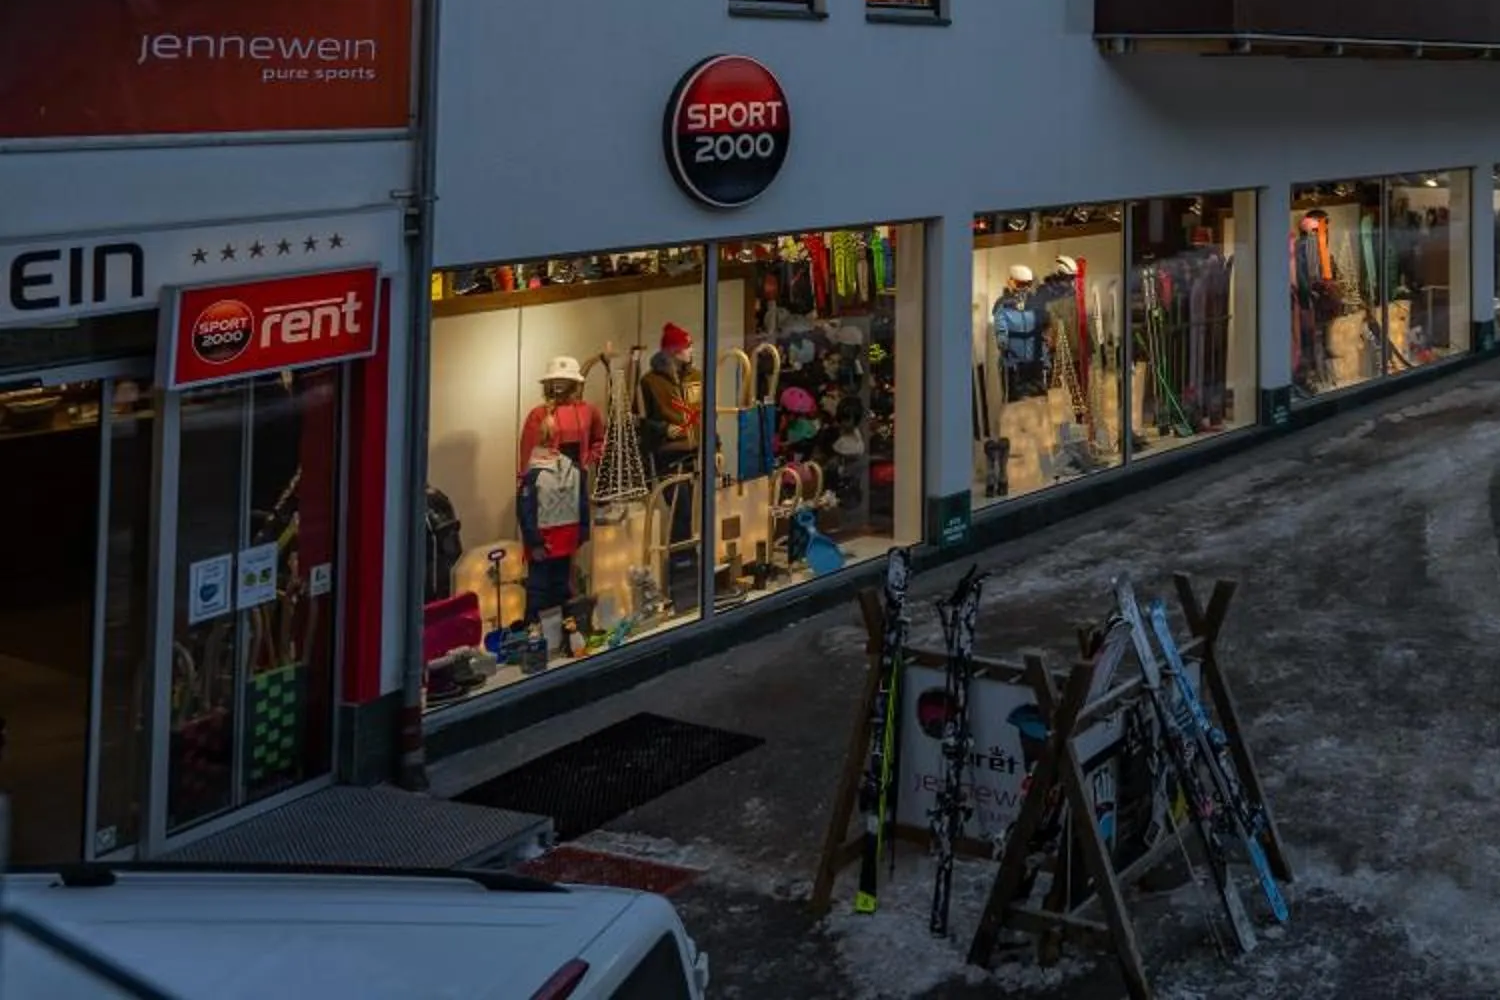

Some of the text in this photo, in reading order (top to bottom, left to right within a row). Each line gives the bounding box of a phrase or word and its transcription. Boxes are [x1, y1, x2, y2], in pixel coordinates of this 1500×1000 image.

[138, 34, 377, 64] jennewein
[263, 67, 376, 82] pure sports
[687, 101, 782, 130] SPORT
[694, 132, 774, 163] 2000
[199, 316, 249, 335] SPORT
[261, 292, 362, 348] rent
[201, 331, 244, 348] 2000
